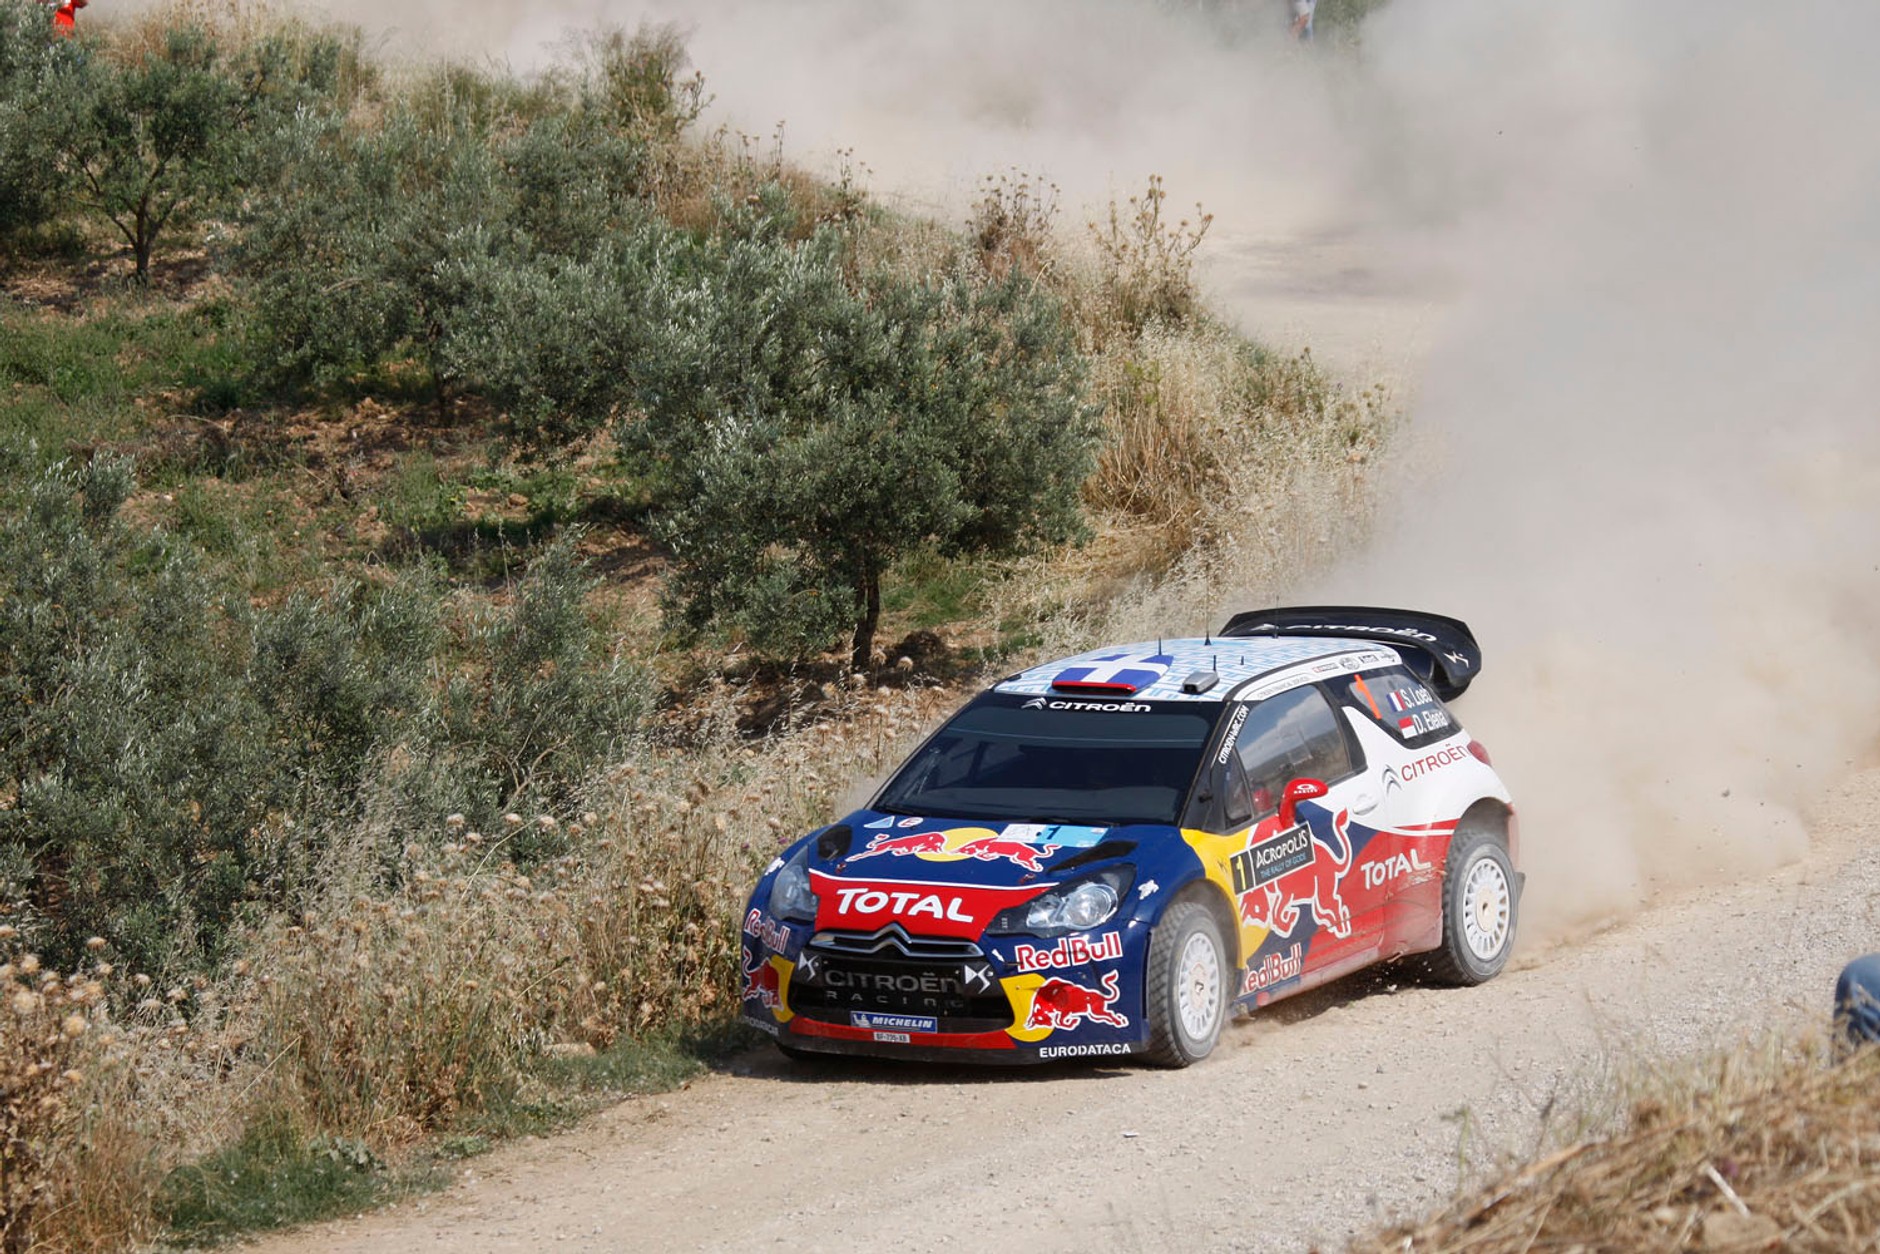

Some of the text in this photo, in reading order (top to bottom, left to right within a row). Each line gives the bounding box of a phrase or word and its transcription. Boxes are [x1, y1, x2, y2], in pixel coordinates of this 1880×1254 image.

[1400, 688, 1416, 708] S.
[1412, 711, 1449, 734] D. Elena
[1256, 829, 1308, 869] ACROPOLIS
[1236, 856, 1246, 890] 1
[1361, 848, 1431, 890] TOTAL
[837, 888, 974, 923] TOTAL
[872, 1016, 932, 1028] MICHELIN
[1040, 1043, 1131, 1058] EURODATACA
